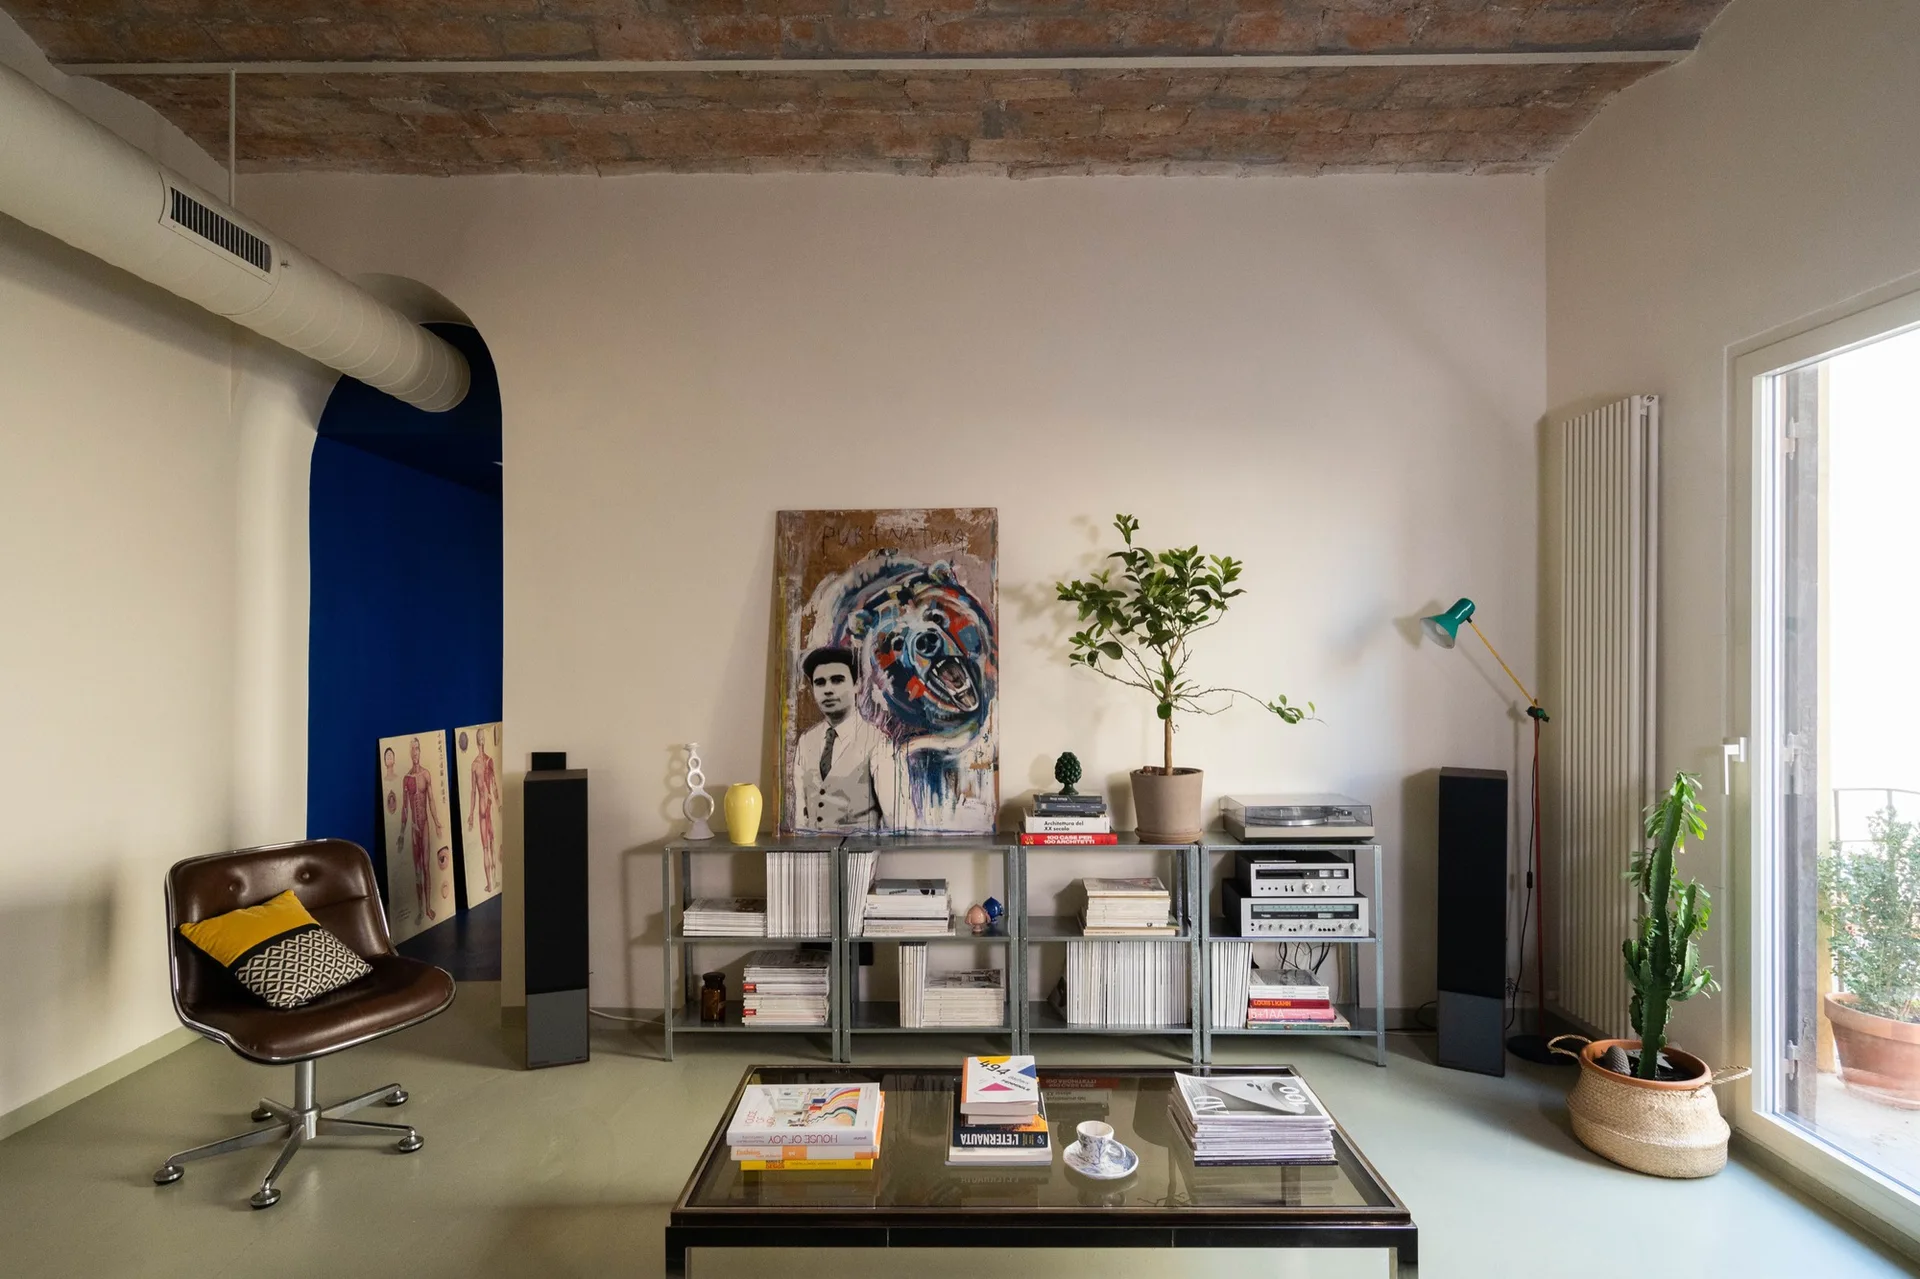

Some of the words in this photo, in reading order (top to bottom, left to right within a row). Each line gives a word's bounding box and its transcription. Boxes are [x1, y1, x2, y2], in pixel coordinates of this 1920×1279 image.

[1279, 1086, 1309, 1106] 100
[1193, 1095, 1229, 1115] AD
[768, 1134, 788, 1144] JOY
[788, 1134, 803, 1144] OF
[804, 1134, 838, 1144] HOUSE
[960, 1133, 1019, 1146] L'ETERNAUTA
